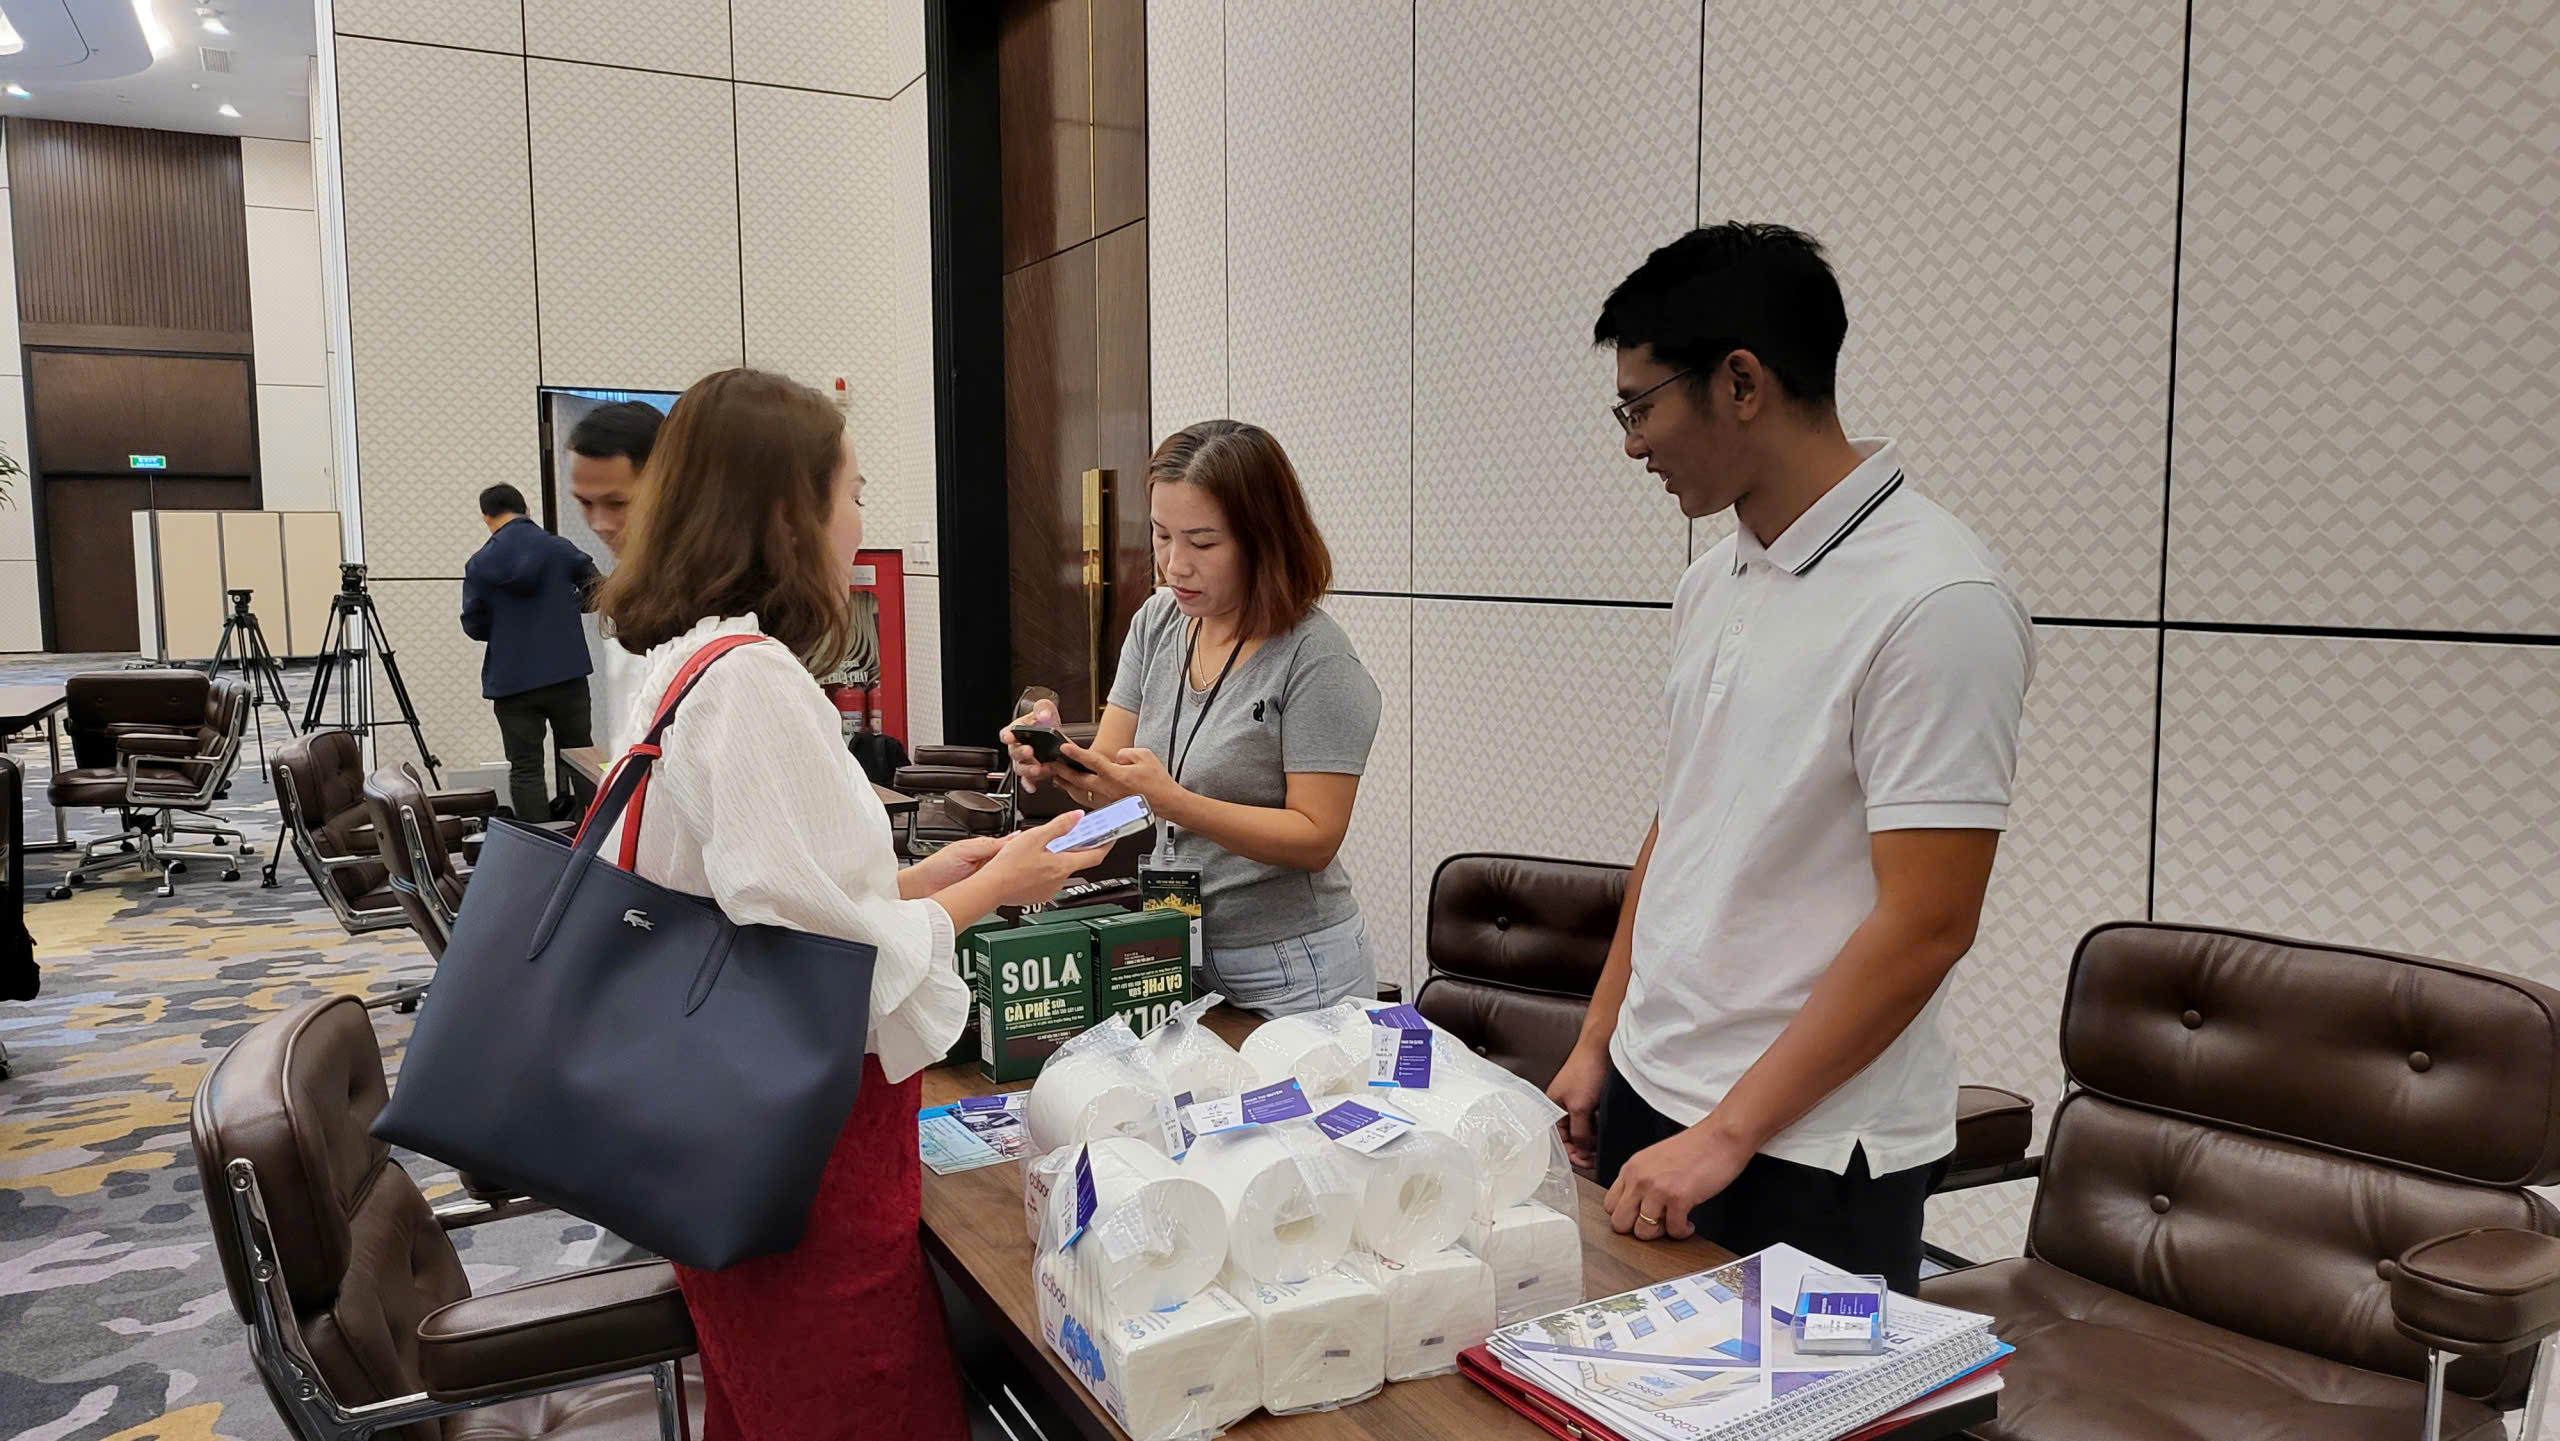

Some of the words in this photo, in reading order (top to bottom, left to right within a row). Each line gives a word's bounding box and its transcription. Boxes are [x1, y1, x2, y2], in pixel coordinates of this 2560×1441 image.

[1066, 882, 1101, 896] SOLA
[1002, 953, 1082, 995] SOLA
[1005, 1002, 1024, 1022] CÀ
[1025, 998, 1050, 1020] PHÊ
